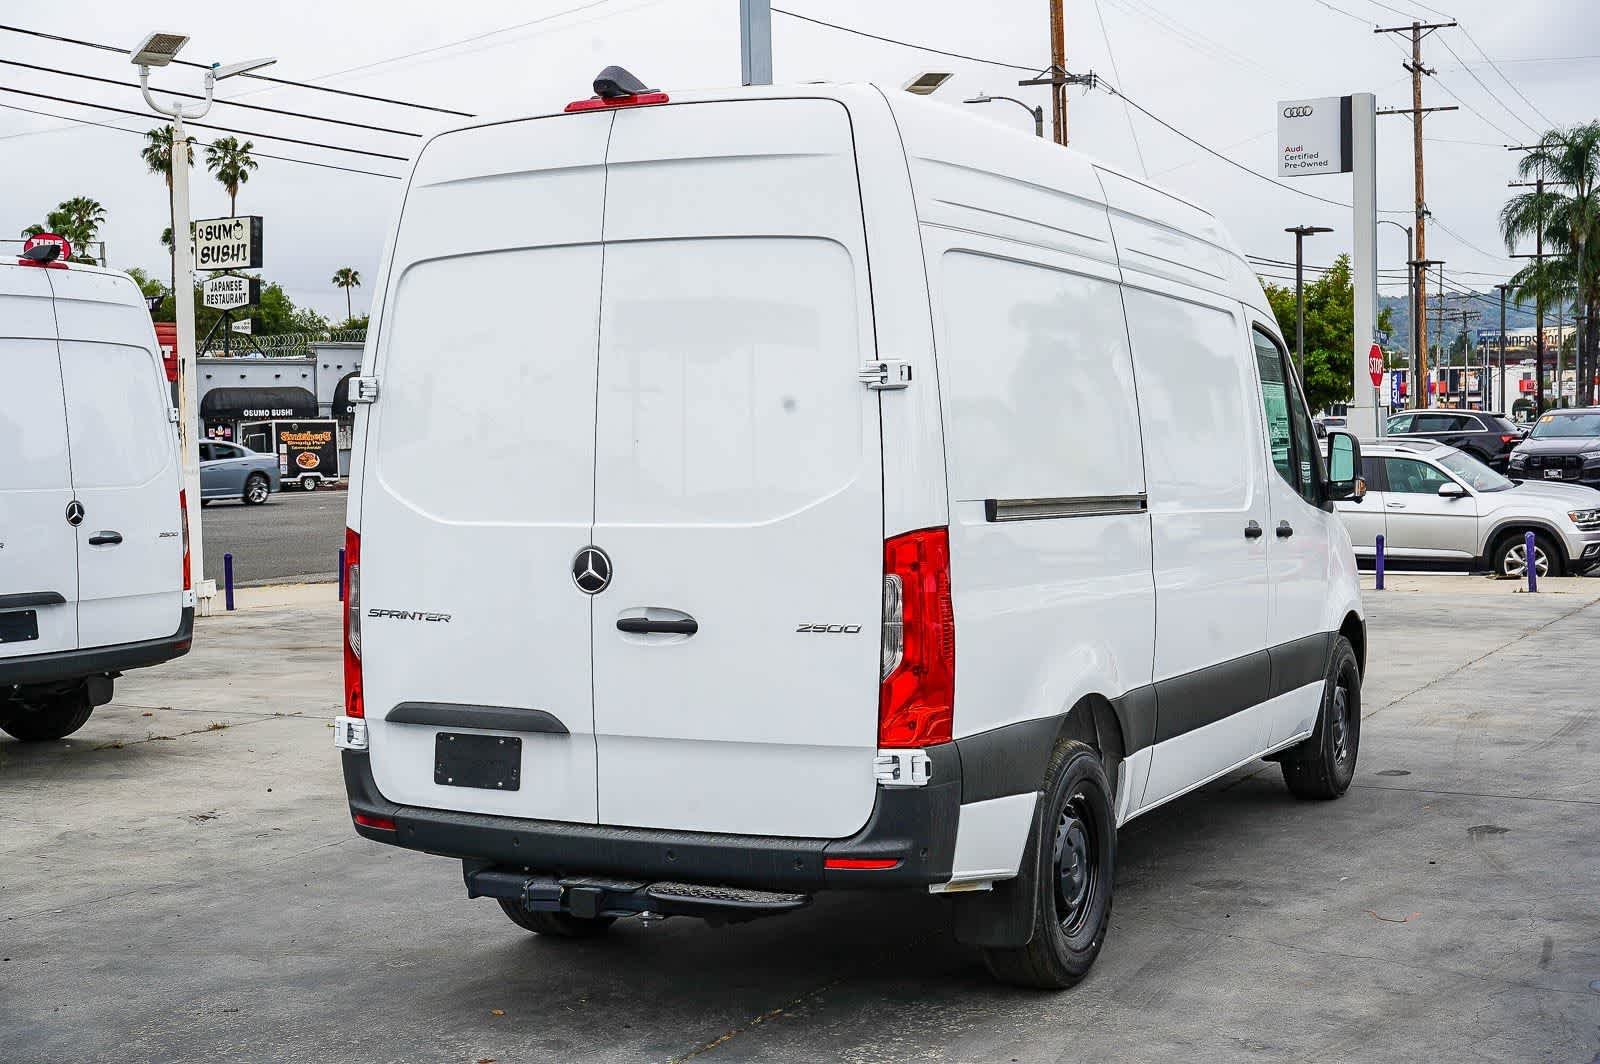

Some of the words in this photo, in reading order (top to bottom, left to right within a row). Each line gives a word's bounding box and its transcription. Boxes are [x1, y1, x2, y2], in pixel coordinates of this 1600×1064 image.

[1285, 145, 1303, 153] Audi
[1284, 152, 1319, 161] Certified
[1284, 160, 1329, 169] Pre-Owned
[201, 244, 247, 264] SUSHI
[210, 281, 242, 293] JAPANESE
[206, 293, 247, 305] RESTAURANT
[1369, 358, 1383, 373] STOP
[243, 409, 270, 417] OSUMO
[271, 408, 293, 417] SUSHI
[368, 608, 451, 622] SPRINTER
[796, 623, 862, 634] 2500
